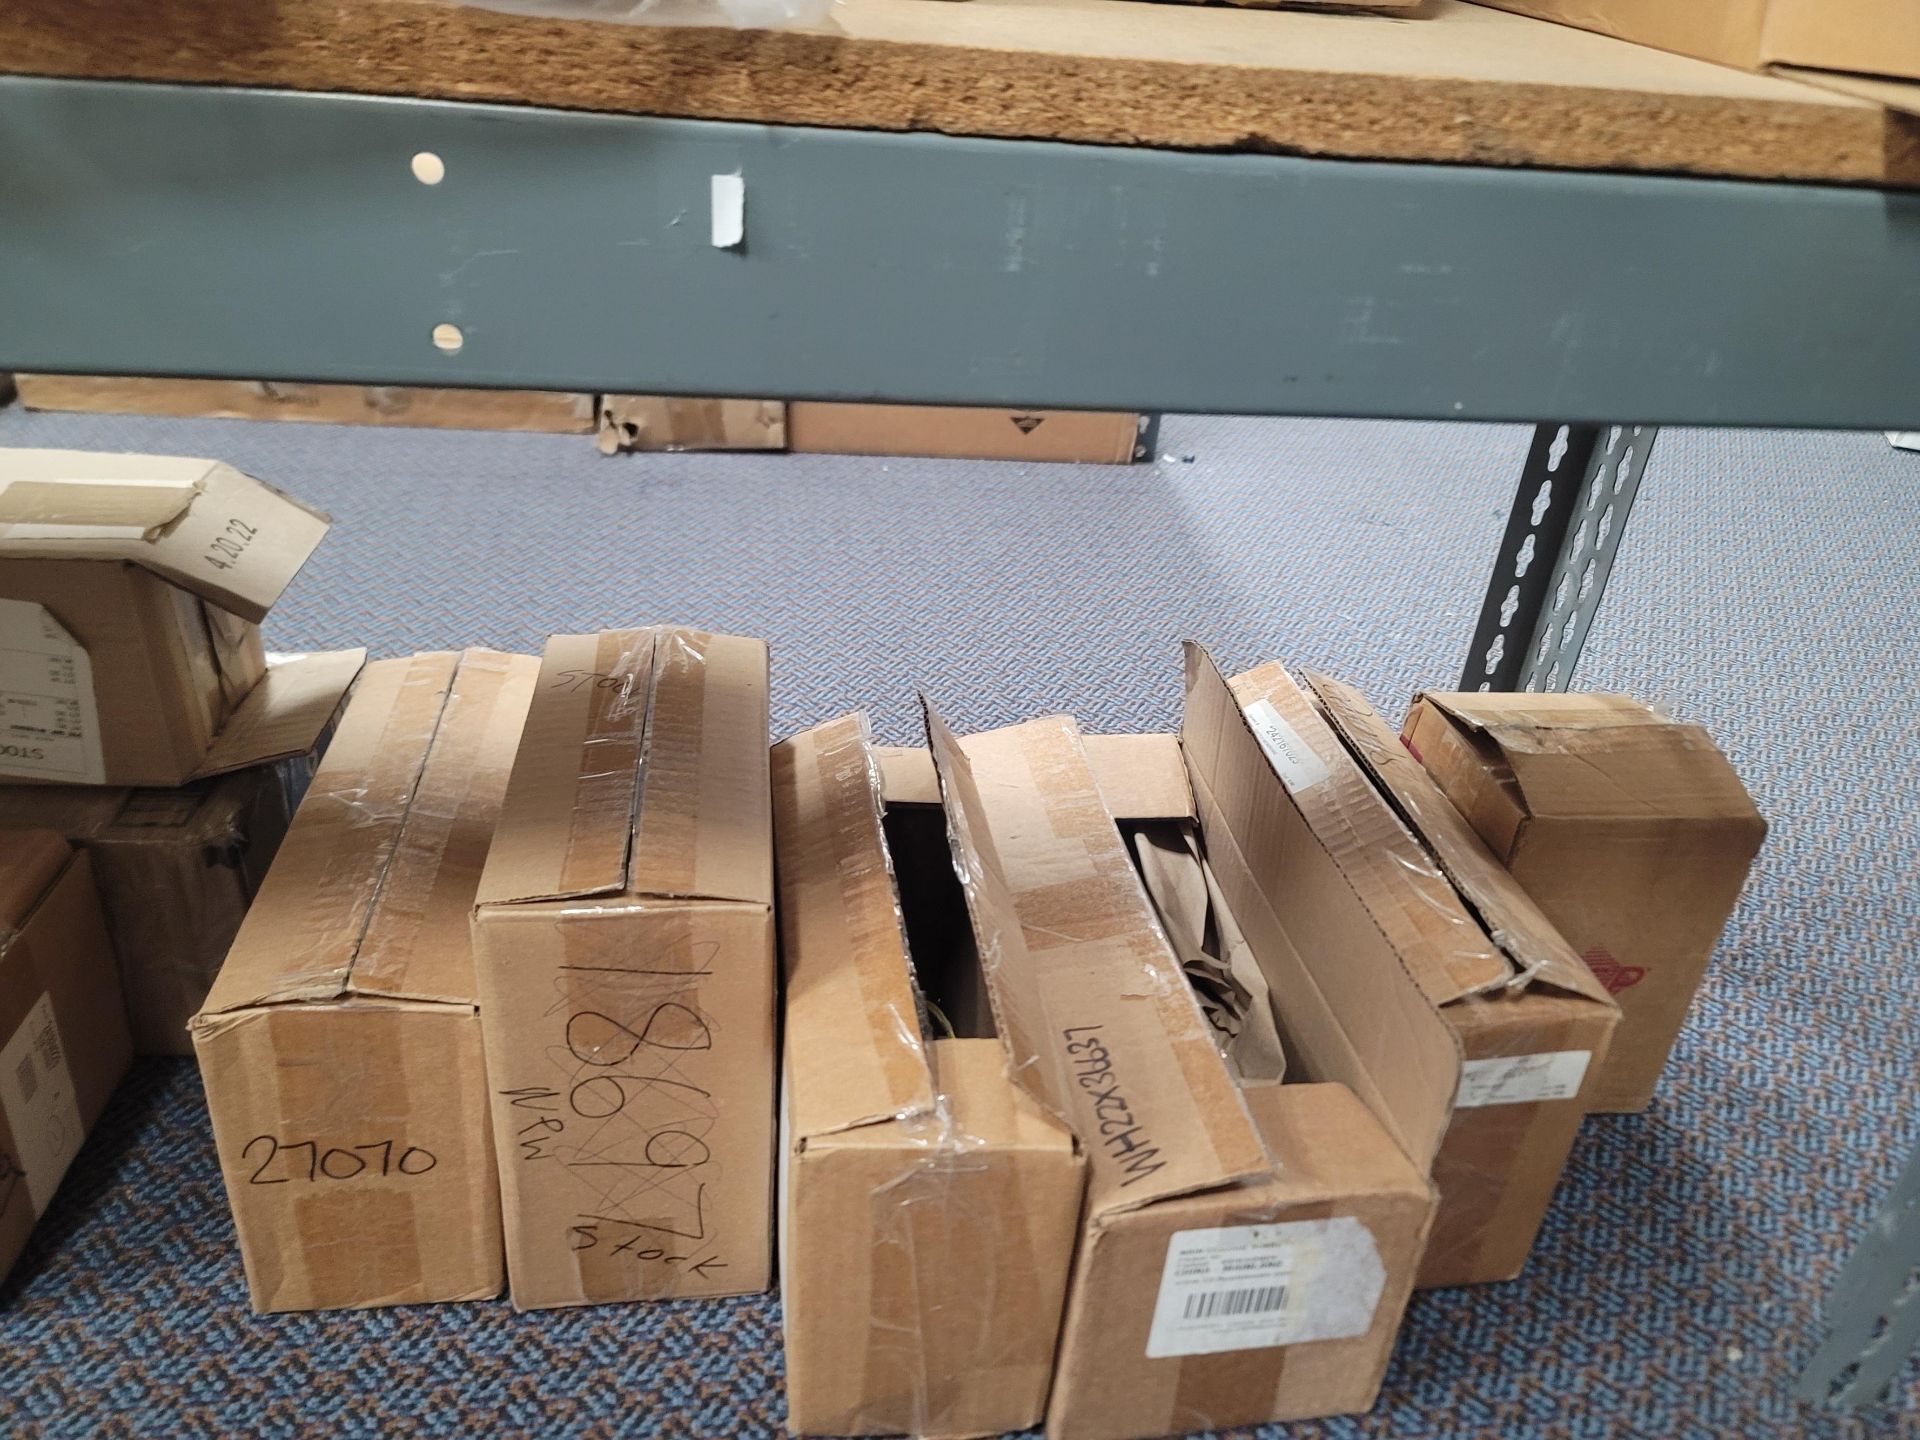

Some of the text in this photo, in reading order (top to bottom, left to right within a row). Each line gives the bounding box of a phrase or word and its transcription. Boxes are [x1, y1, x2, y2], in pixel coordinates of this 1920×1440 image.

[205, 518, 259, 572] 4.20.22
[1062, 1024, 1168, 1188] WH22X36637
[241, 1134, 438, 1185] 27070
